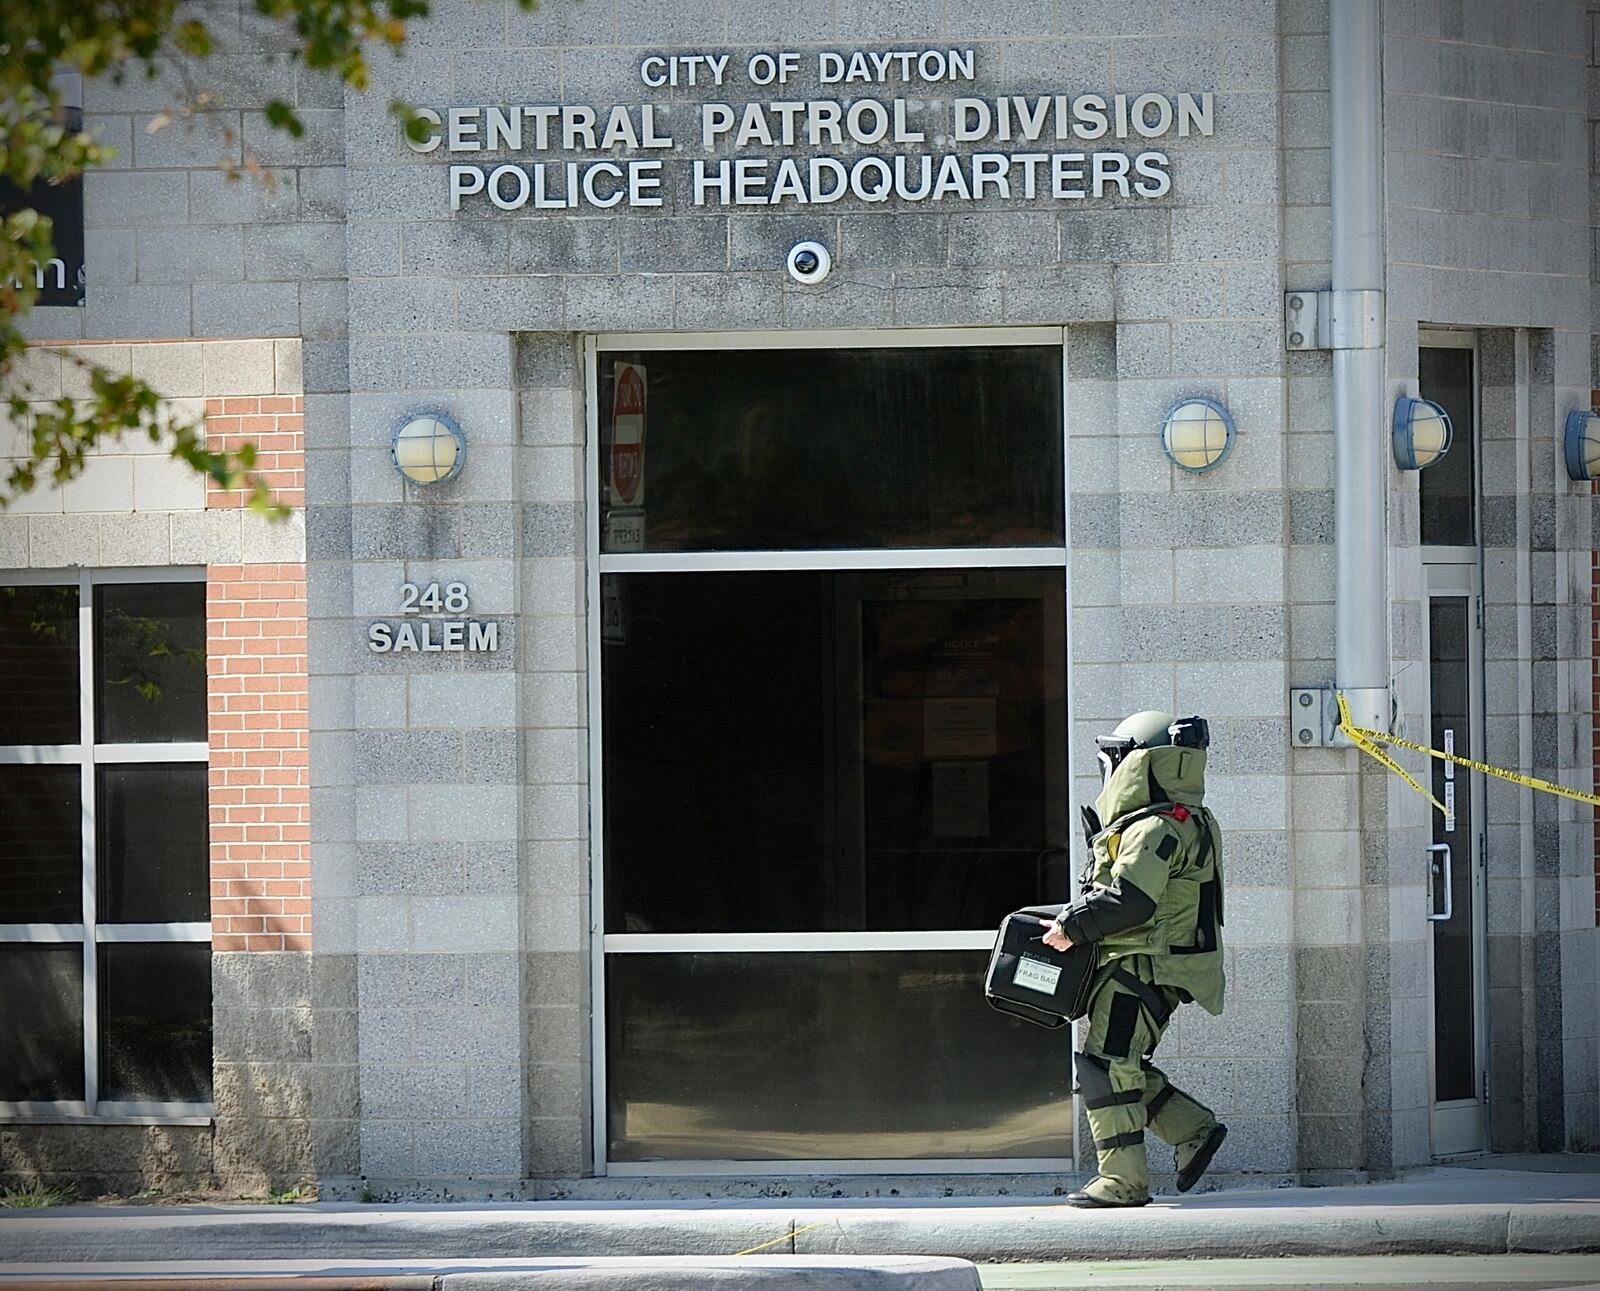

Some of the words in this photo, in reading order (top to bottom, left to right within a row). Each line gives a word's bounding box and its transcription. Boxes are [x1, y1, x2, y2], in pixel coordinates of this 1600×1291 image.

[641, 55, 730, 87] CITY
[748, 53, 801, 86] OF
[819, 50, 975, 84] DAYTON
[404, 104, 673, 153] CENTRAL
[702, 98, 925, 148] PATROL
[954, 92, 1214, 142] DIVISION
[449, 160, 663, 211] POLICE
[693, 151, 1172, 206] HEADQUARTERS
[400, 582, 470, 613] 248
[368, 621, 498, 653] SALEM
[1019, 969, 1040, 980] FRAG
[1040, 975, 1056, 985] BAG
